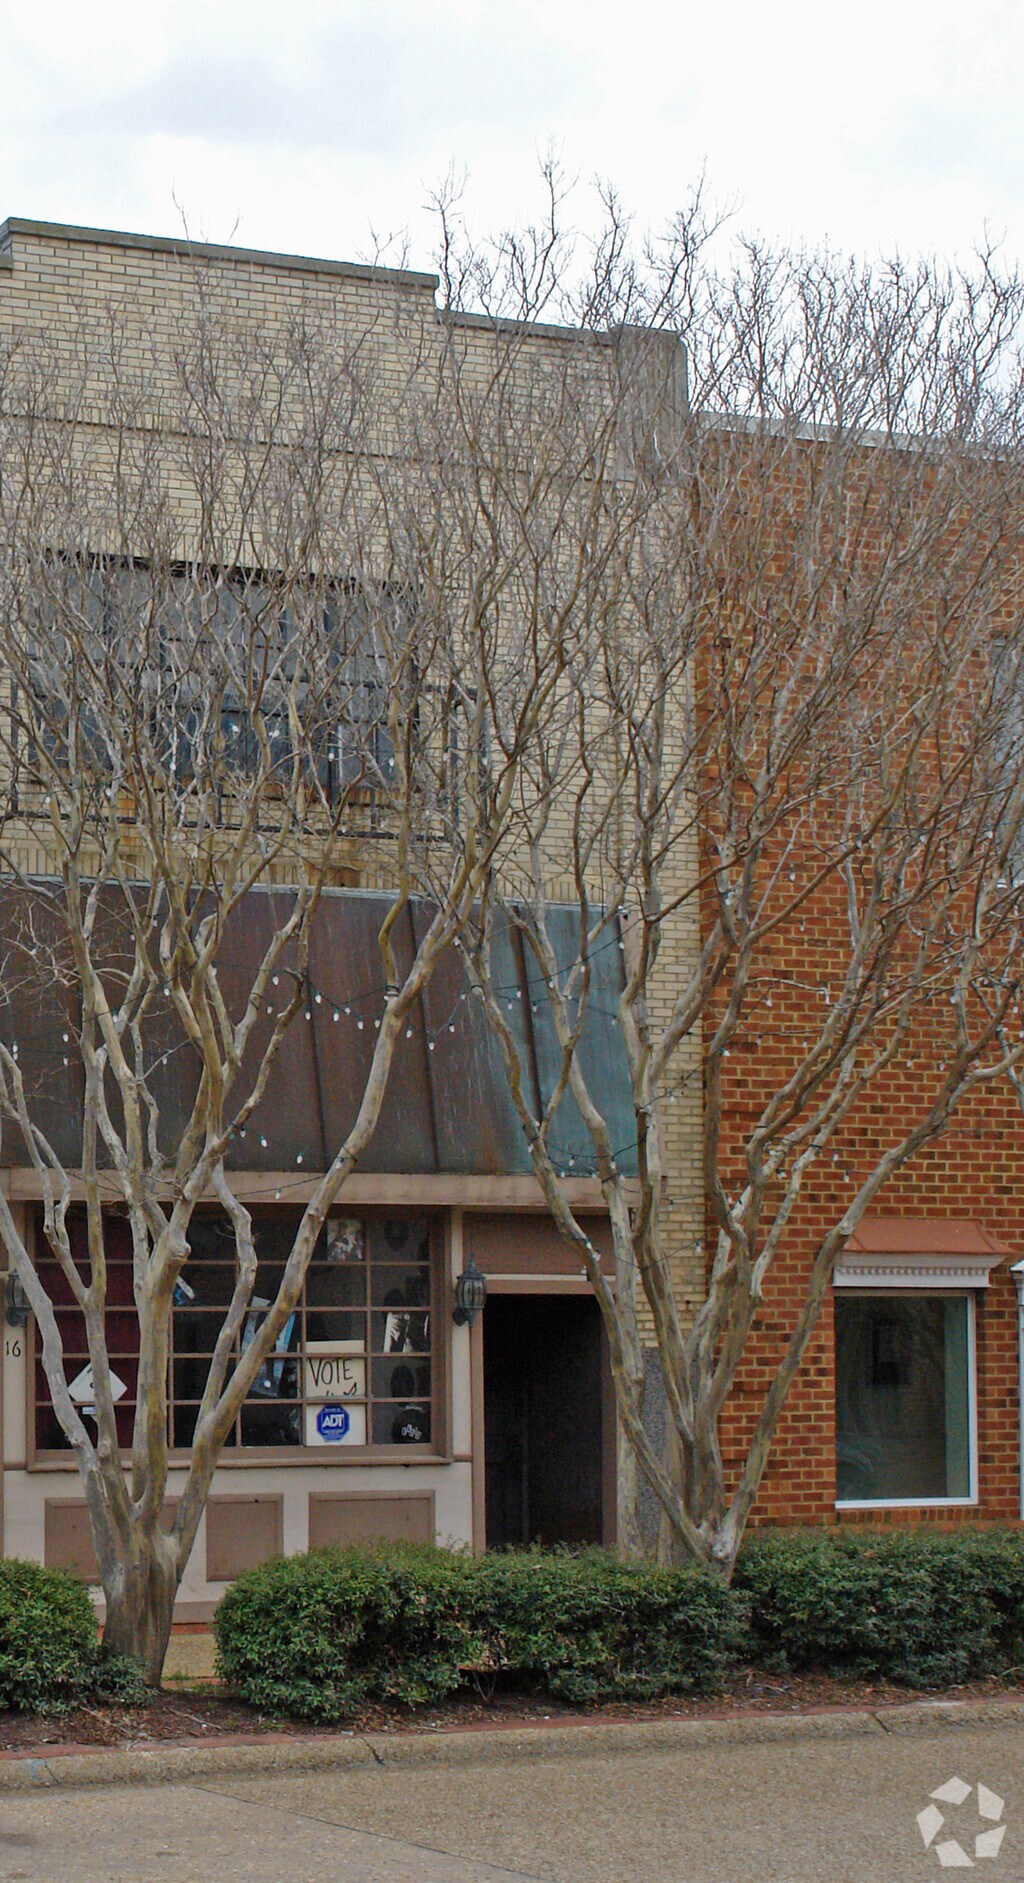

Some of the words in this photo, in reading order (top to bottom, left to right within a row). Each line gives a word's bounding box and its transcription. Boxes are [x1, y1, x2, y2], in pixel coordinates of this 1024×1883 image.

[6, 1340, 21, 1357] 16
[308, 1358, 353, 1387] VOTE
[321, 1413, 344, 1428] ADT
